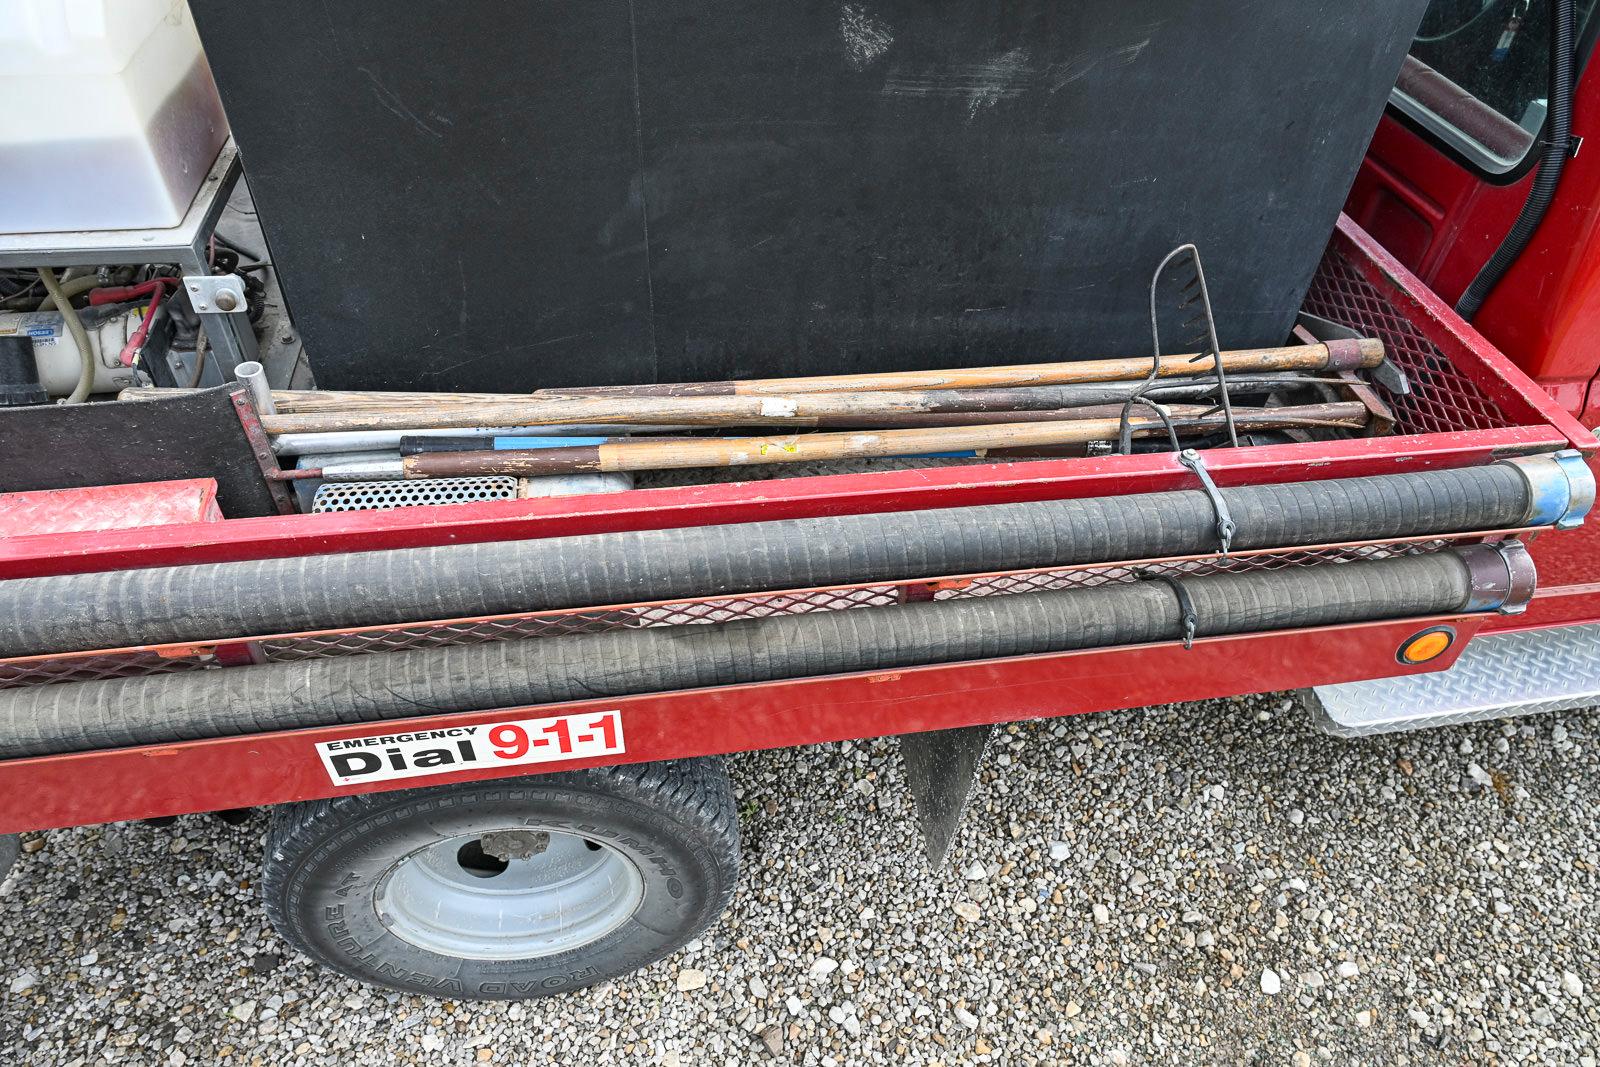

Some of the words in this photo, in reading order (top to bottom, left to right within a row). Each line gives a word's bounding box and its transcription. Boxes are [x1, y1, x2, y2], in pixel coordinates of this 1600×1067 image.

[326, 726, 478, 751] EMERGENCY
[329, 739, 477, 778] Dial
[488, 714, 617, 759] 9-1-1
[524, 818, 684, 900] KUMHO
[335, 871, 364, 898] AT
[325, 903, 463, 992] VENTURE
[478, 965, 600, 995] ROAD
